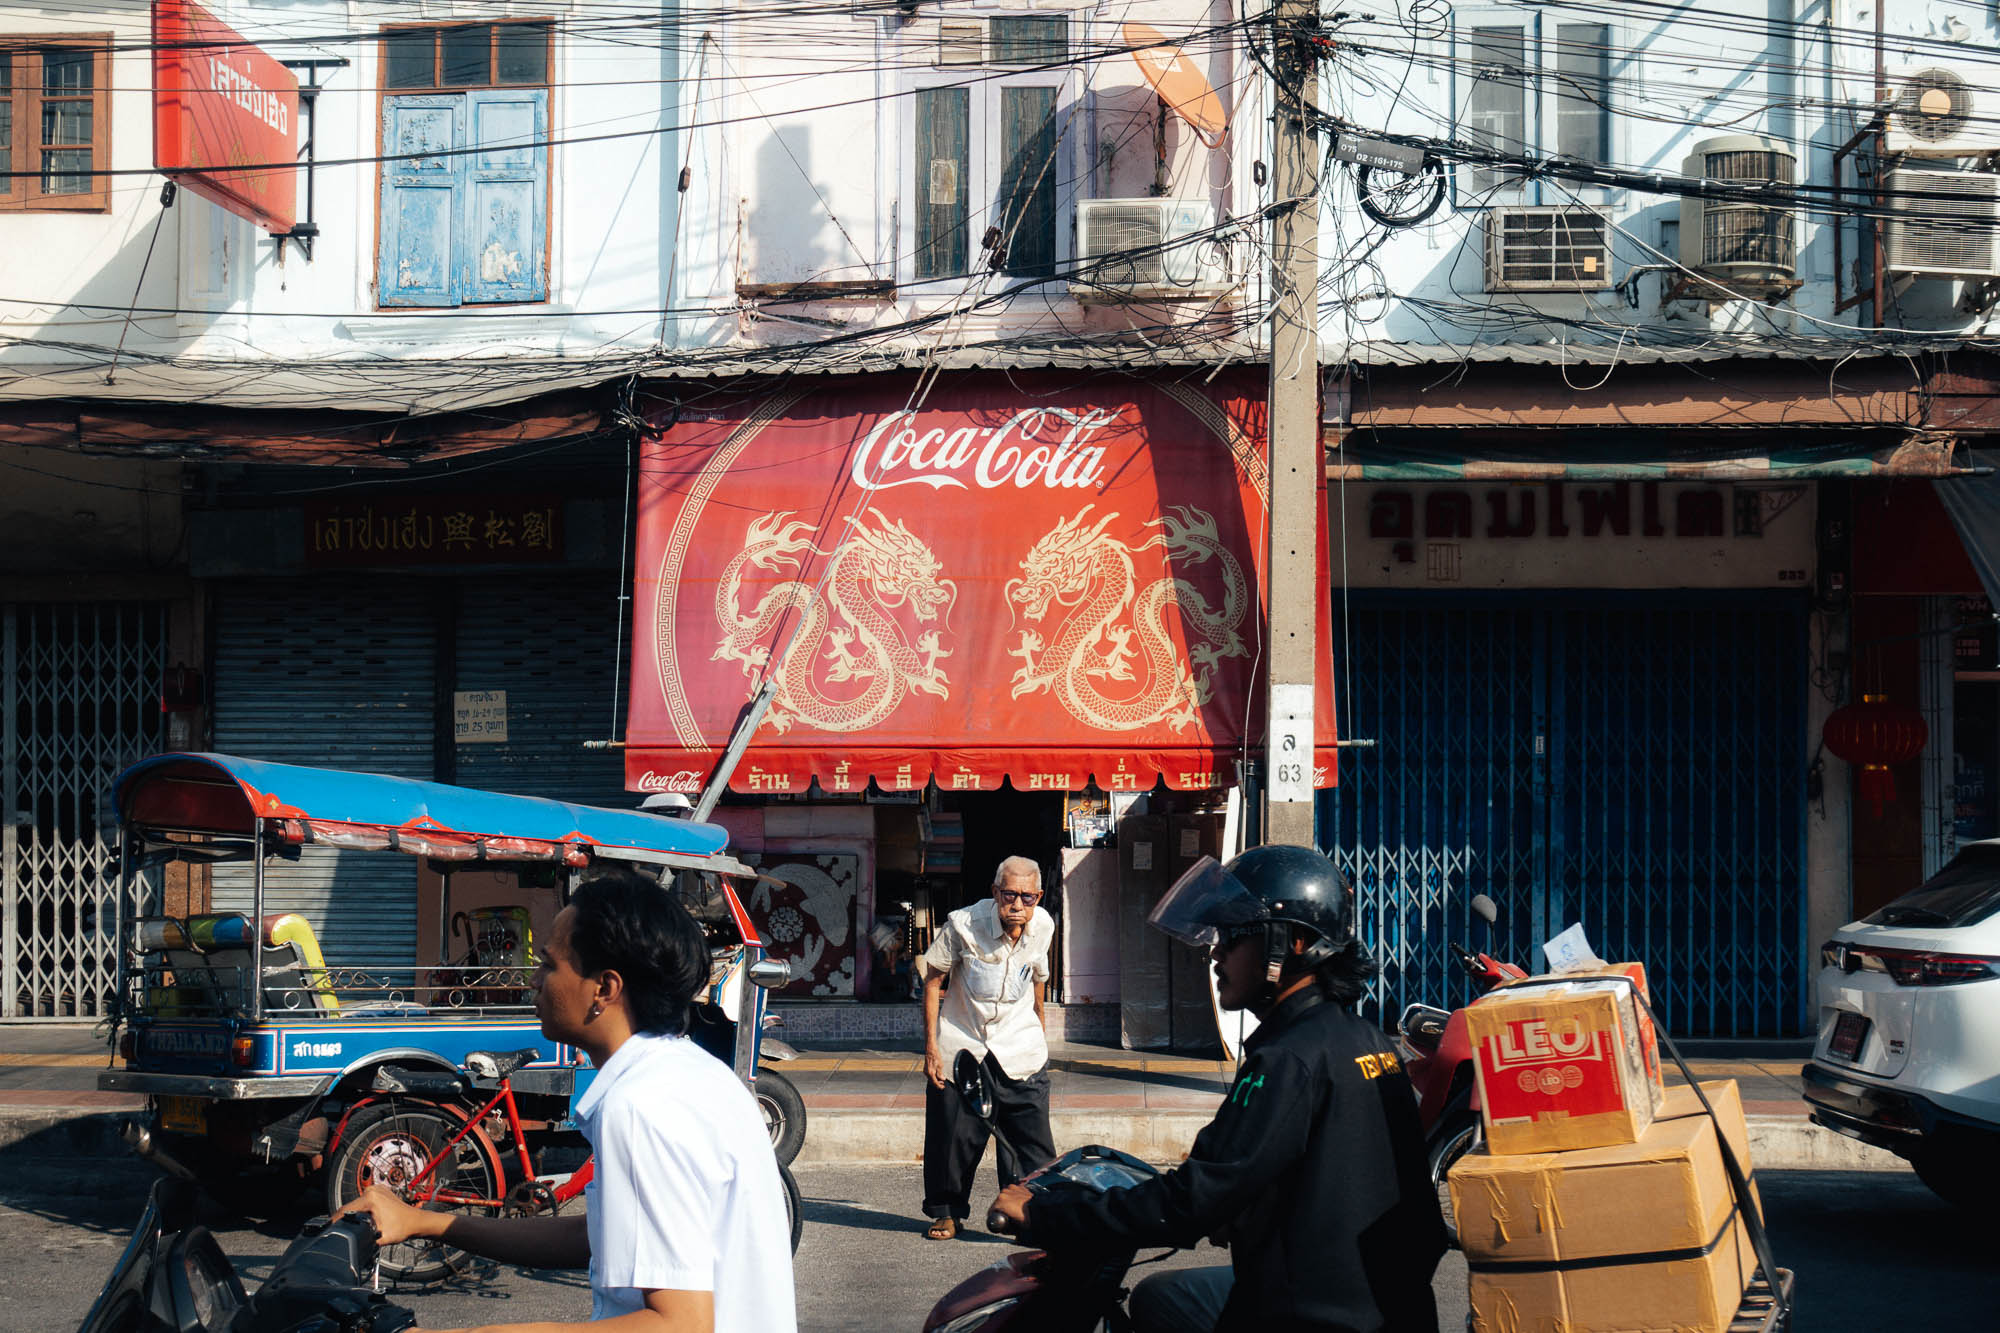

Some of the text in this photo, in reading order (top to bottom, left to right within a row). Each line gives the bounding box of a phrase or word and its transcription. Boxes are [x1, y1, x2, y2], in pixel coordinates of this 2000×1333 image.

[852, 407, 1122, 491] Coca-Cola
[638, 771, 703, 792] Coca-Cola
[748, 767, 791, 790] ร้าน
[834, 761, 852, 790] นี้
[896, 764, 913, 789] ดี
[952, 766, 982, 790] ค้า
[1030, 773, 1071, 789] ขาย
[1180, 773, 1222, 790] รวย
[1279, 764, 1302, 783] 63
[1500, 1016, 1594, 1062] LEO
